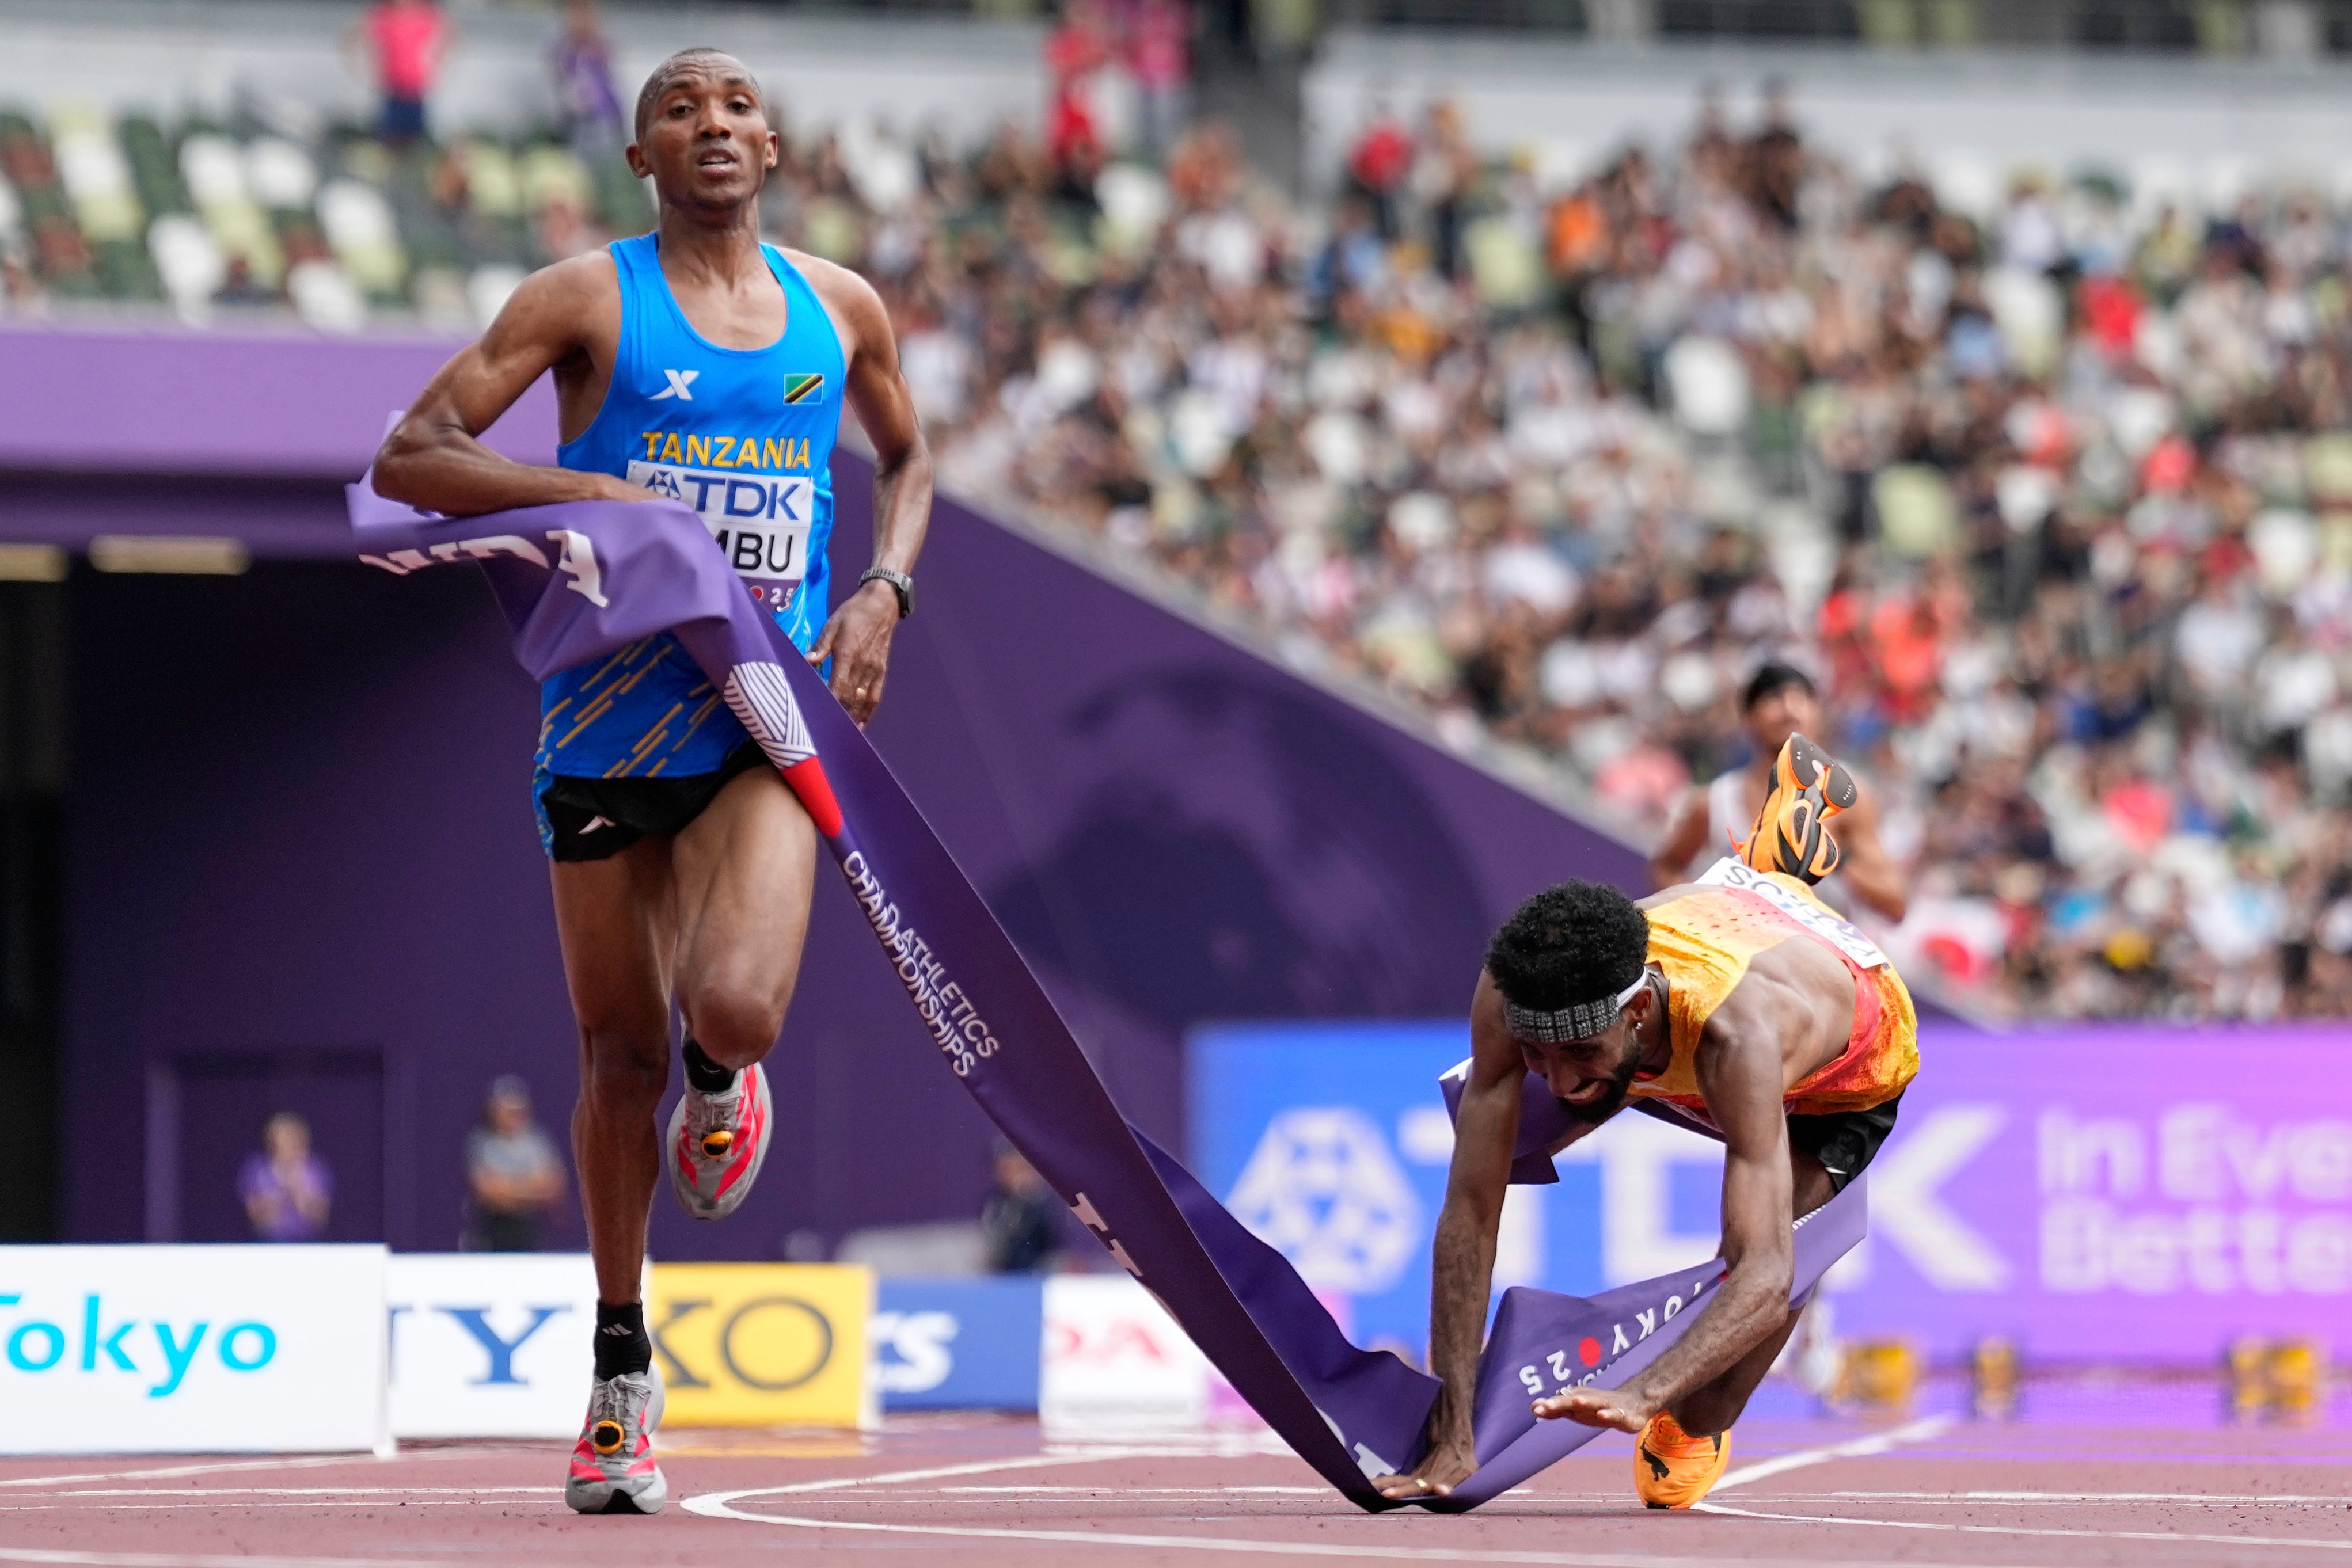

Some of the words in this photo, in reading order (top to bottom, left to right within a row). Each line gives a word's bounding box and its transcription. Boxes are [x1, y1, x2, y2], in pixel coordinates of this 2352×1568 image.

[642, 431, 811, 469] TANZANIA
[683, 474, 801, 520] TDK
[843, 850, 976, 1078] CHAMPIONSHIPS
[900, 927, 1000, 1059] ATHLETICS
[2040, 1108, 2143, 1194] In
